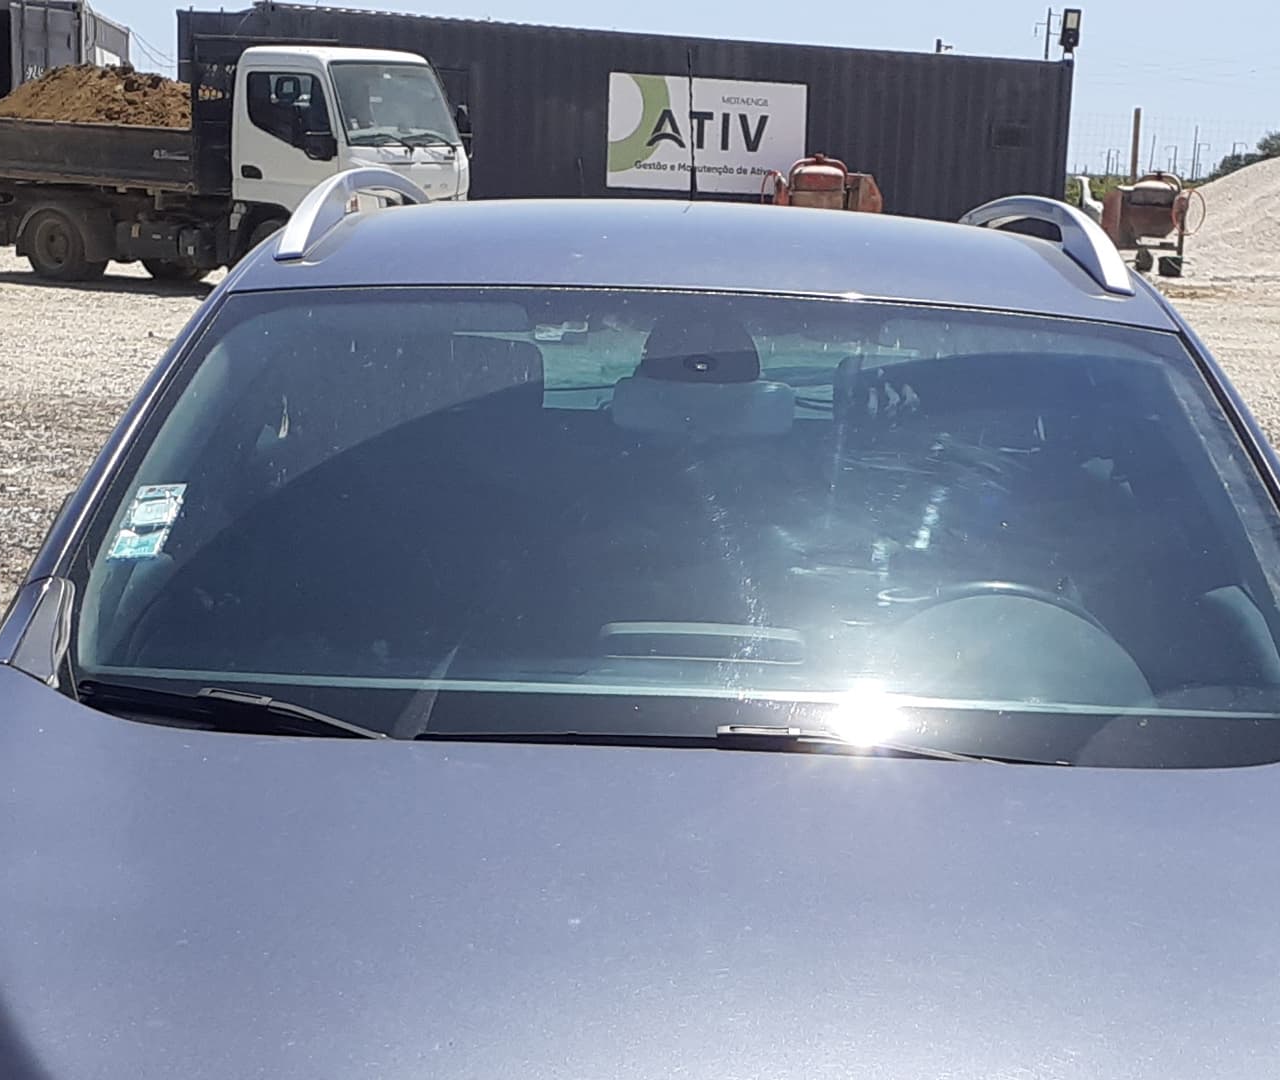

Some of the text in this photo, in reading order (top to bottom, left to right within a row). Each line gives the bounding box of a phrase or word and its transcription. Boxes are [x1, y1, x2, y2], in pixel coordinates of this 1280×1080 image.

[646, 109, 769, 152] ATIV
[634, 160, 668, 171] Gestão
[736, 166, 748, 175] de
